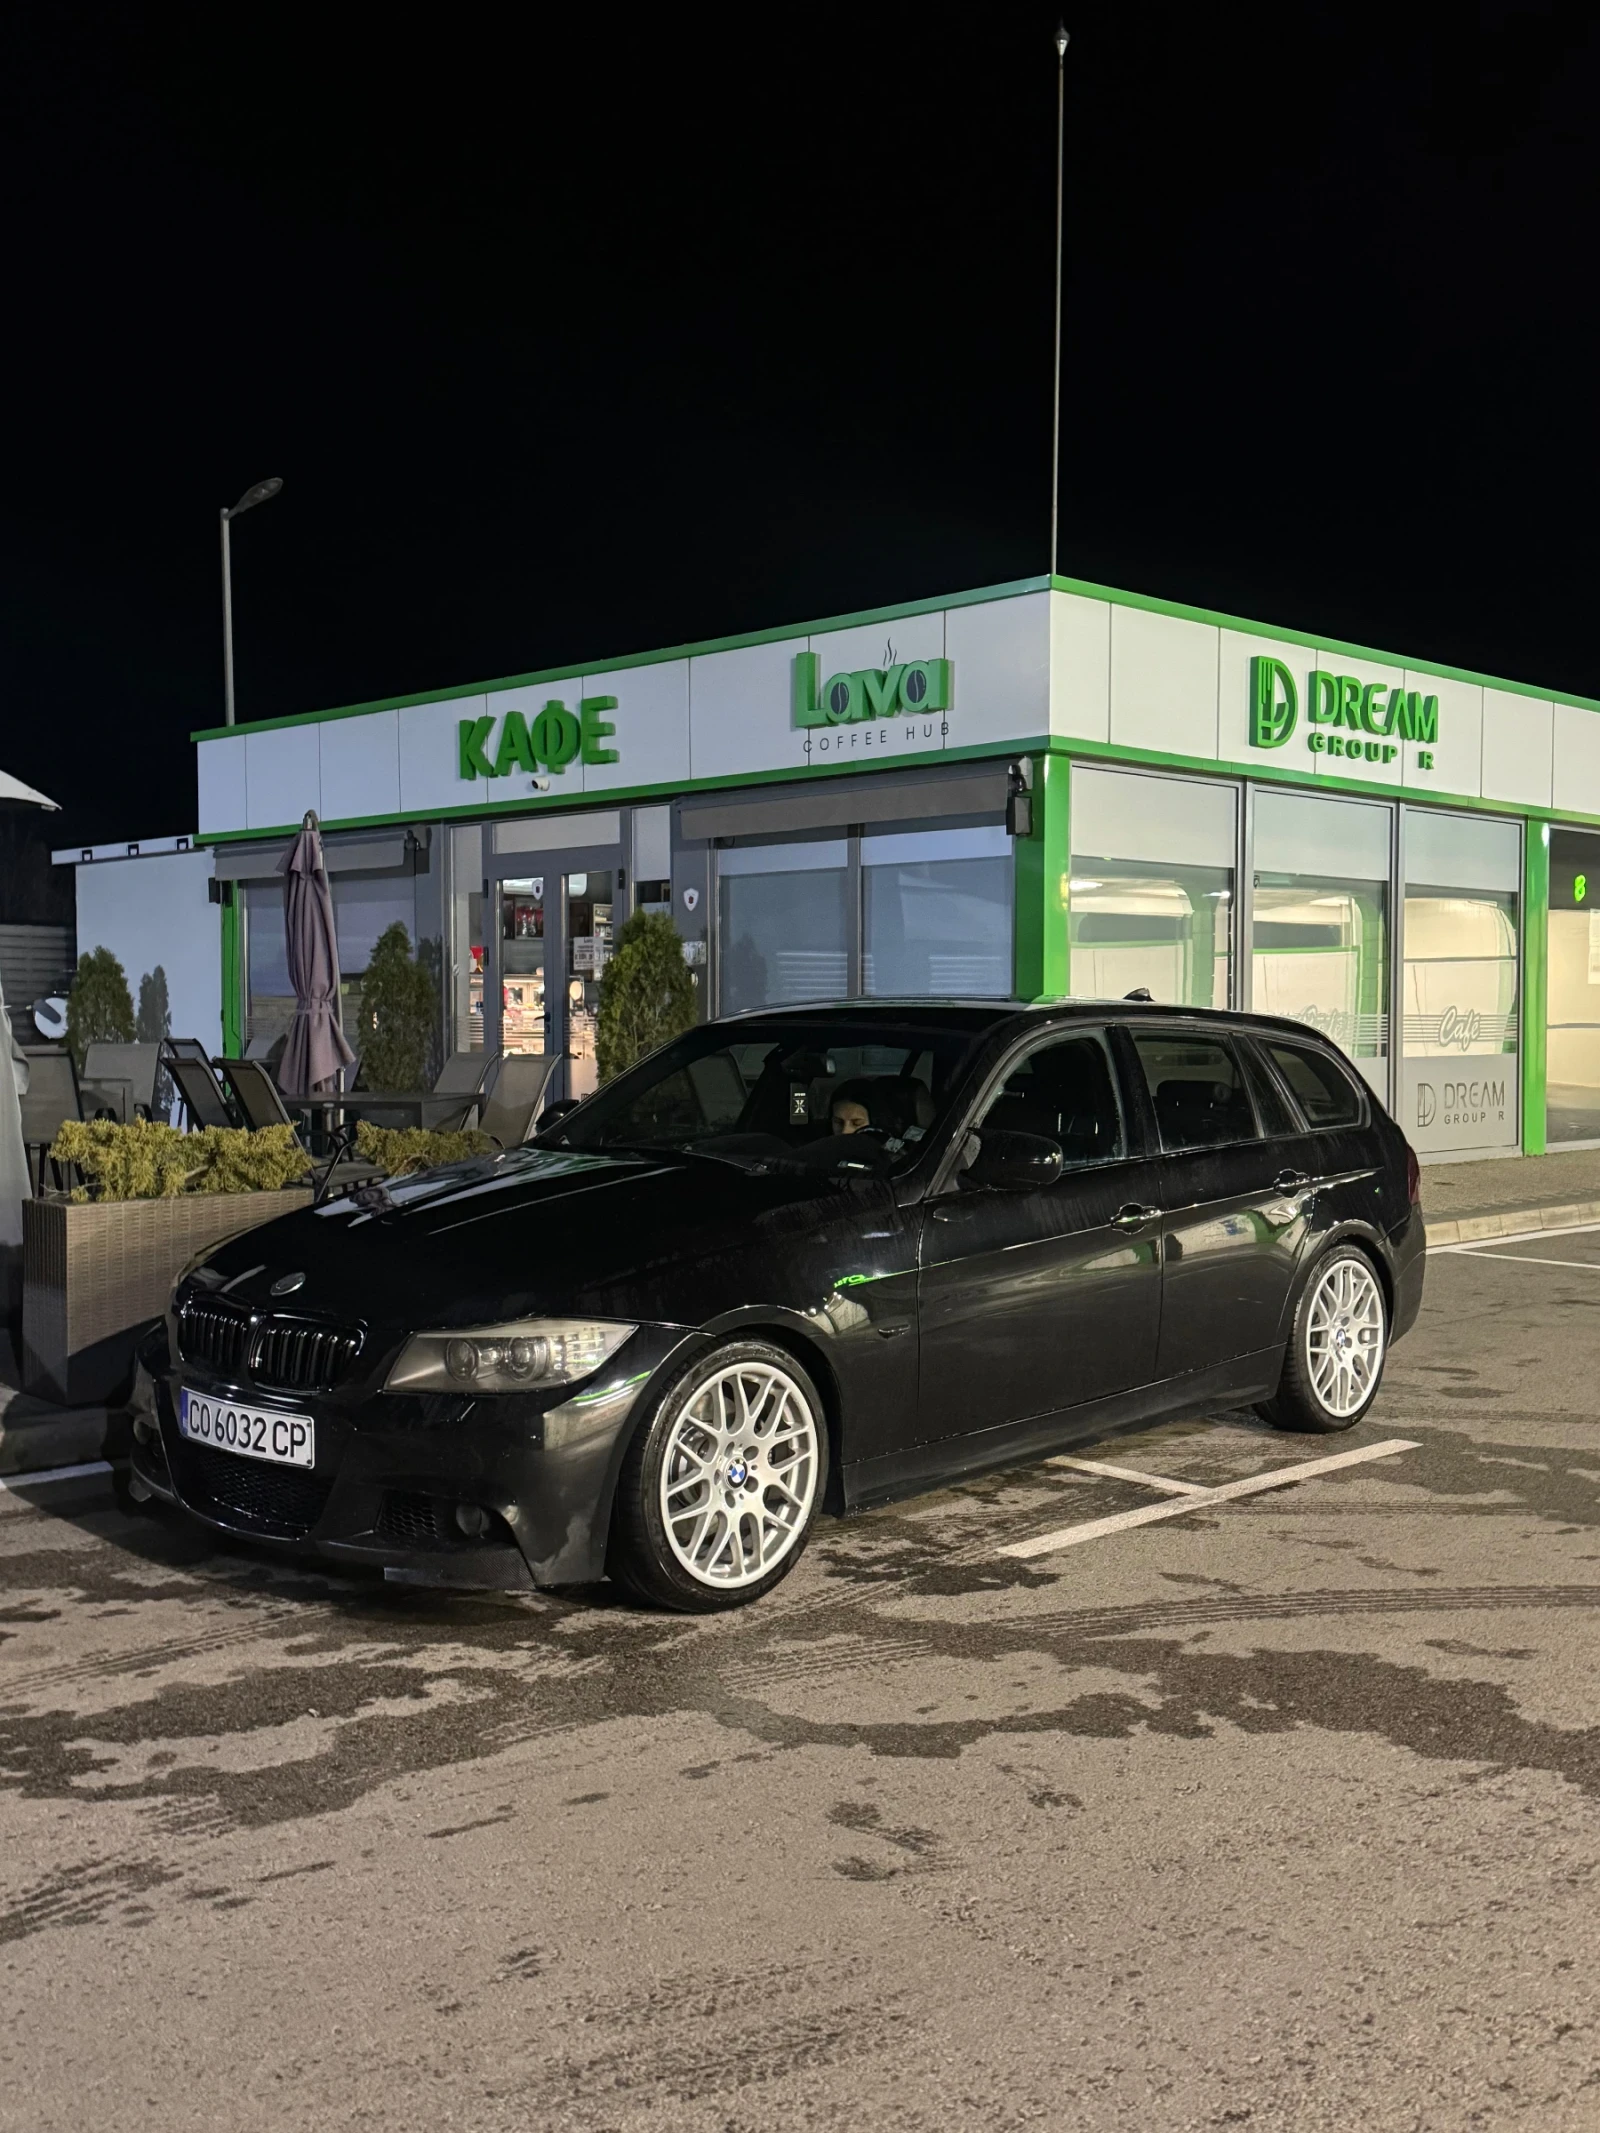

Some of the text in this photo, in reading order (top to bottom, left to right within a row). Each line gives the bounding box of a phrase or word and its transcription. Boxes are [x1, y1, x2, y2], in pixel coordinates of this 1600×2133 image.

[795, 652, 949, 729] Lava
[1308, 670, 1438, 744] DREAM
[459, 696, 619, 780] КАФЕ
[803, 721, 949, 753] COFFEE HUB
[1308, 732, 1435, 770] GROUP R
[1439, 1004, 1481, 1052] Café
[1443, 1080, 1505, 1110] DREAM
[1444, 1110, 1505, 1125] GROUP R
